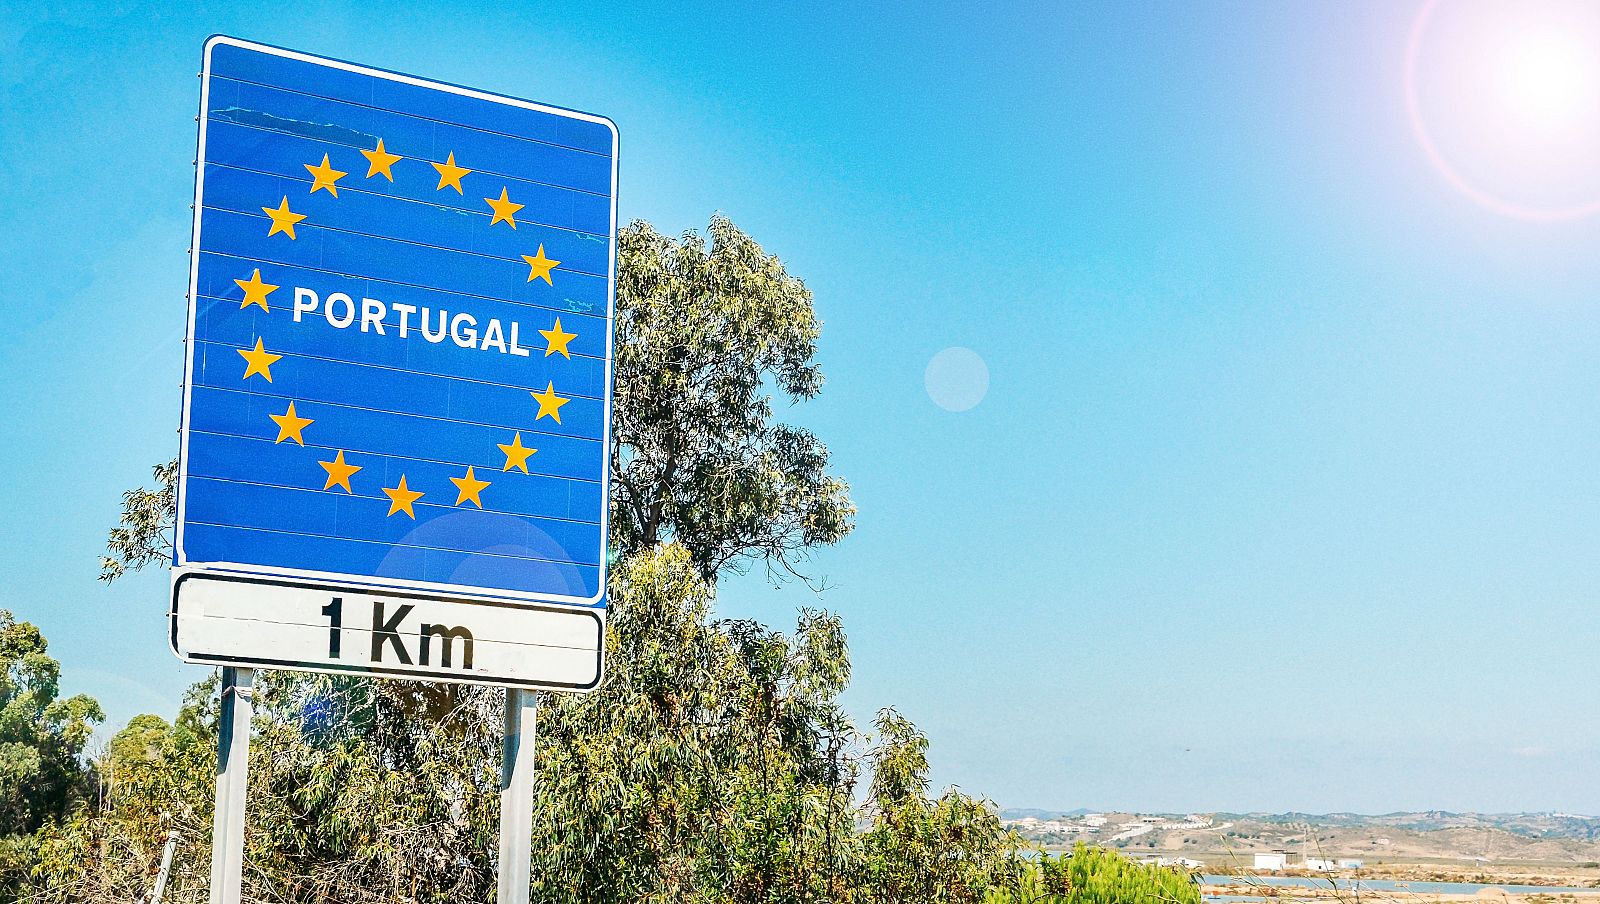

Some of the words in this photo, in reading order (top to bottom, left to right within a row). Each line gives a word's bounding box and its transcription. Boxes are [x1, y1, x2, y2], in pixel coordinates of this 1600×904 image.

[293, 286, 530, 357] PORTUGAL
[321, 597, 342, 659] 1
[371, 601, 474, 670] Km
